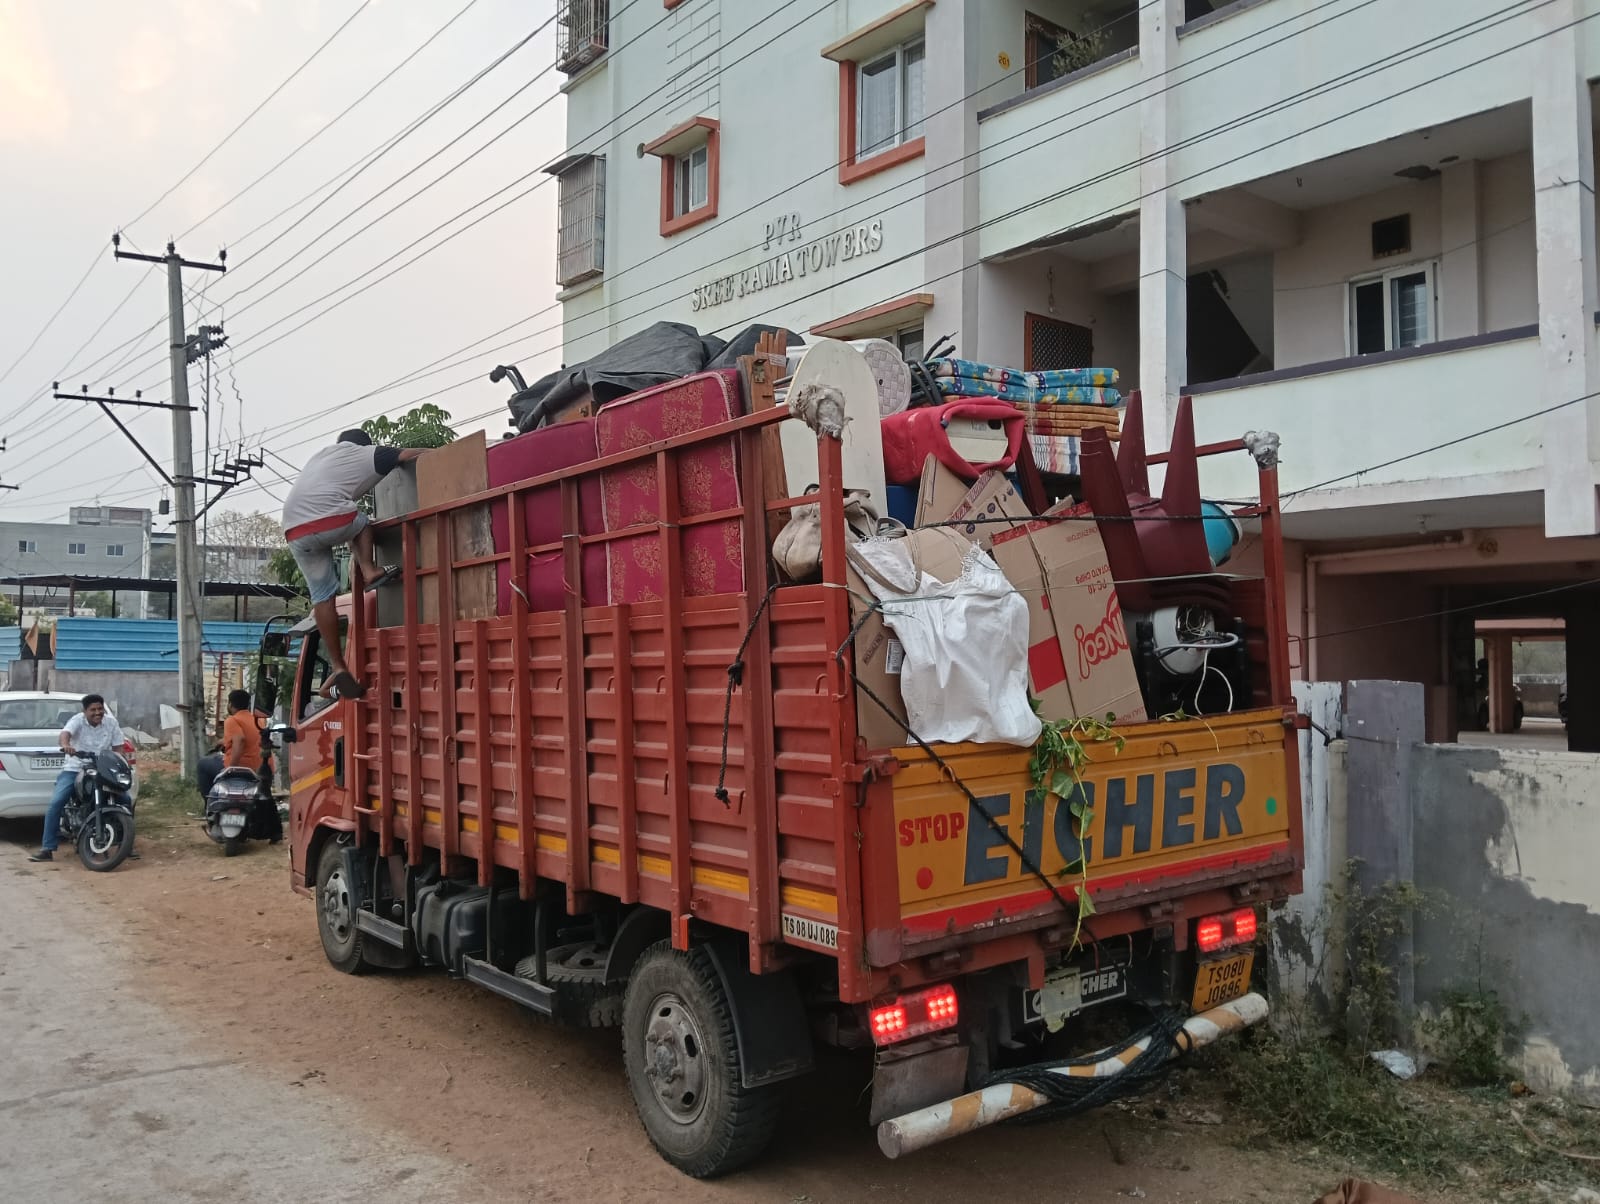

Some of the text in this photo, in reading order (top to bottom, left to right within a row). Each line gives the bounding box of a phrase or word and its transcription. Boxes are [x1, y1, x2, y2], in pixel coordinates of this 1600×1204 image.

[762, 212, 802, 251] PVR
[692, 219, 883, 312] SREE RAMA TOWERS
[898, 812, 965, 847] STOP
[964, 763, 1246, 886] EICHER
[784, 916, 838, 946] TS 08 UJ 089
[1208, 958, 1246, 985] TS08U
[1203, 978, 1242, 1006] J0896
